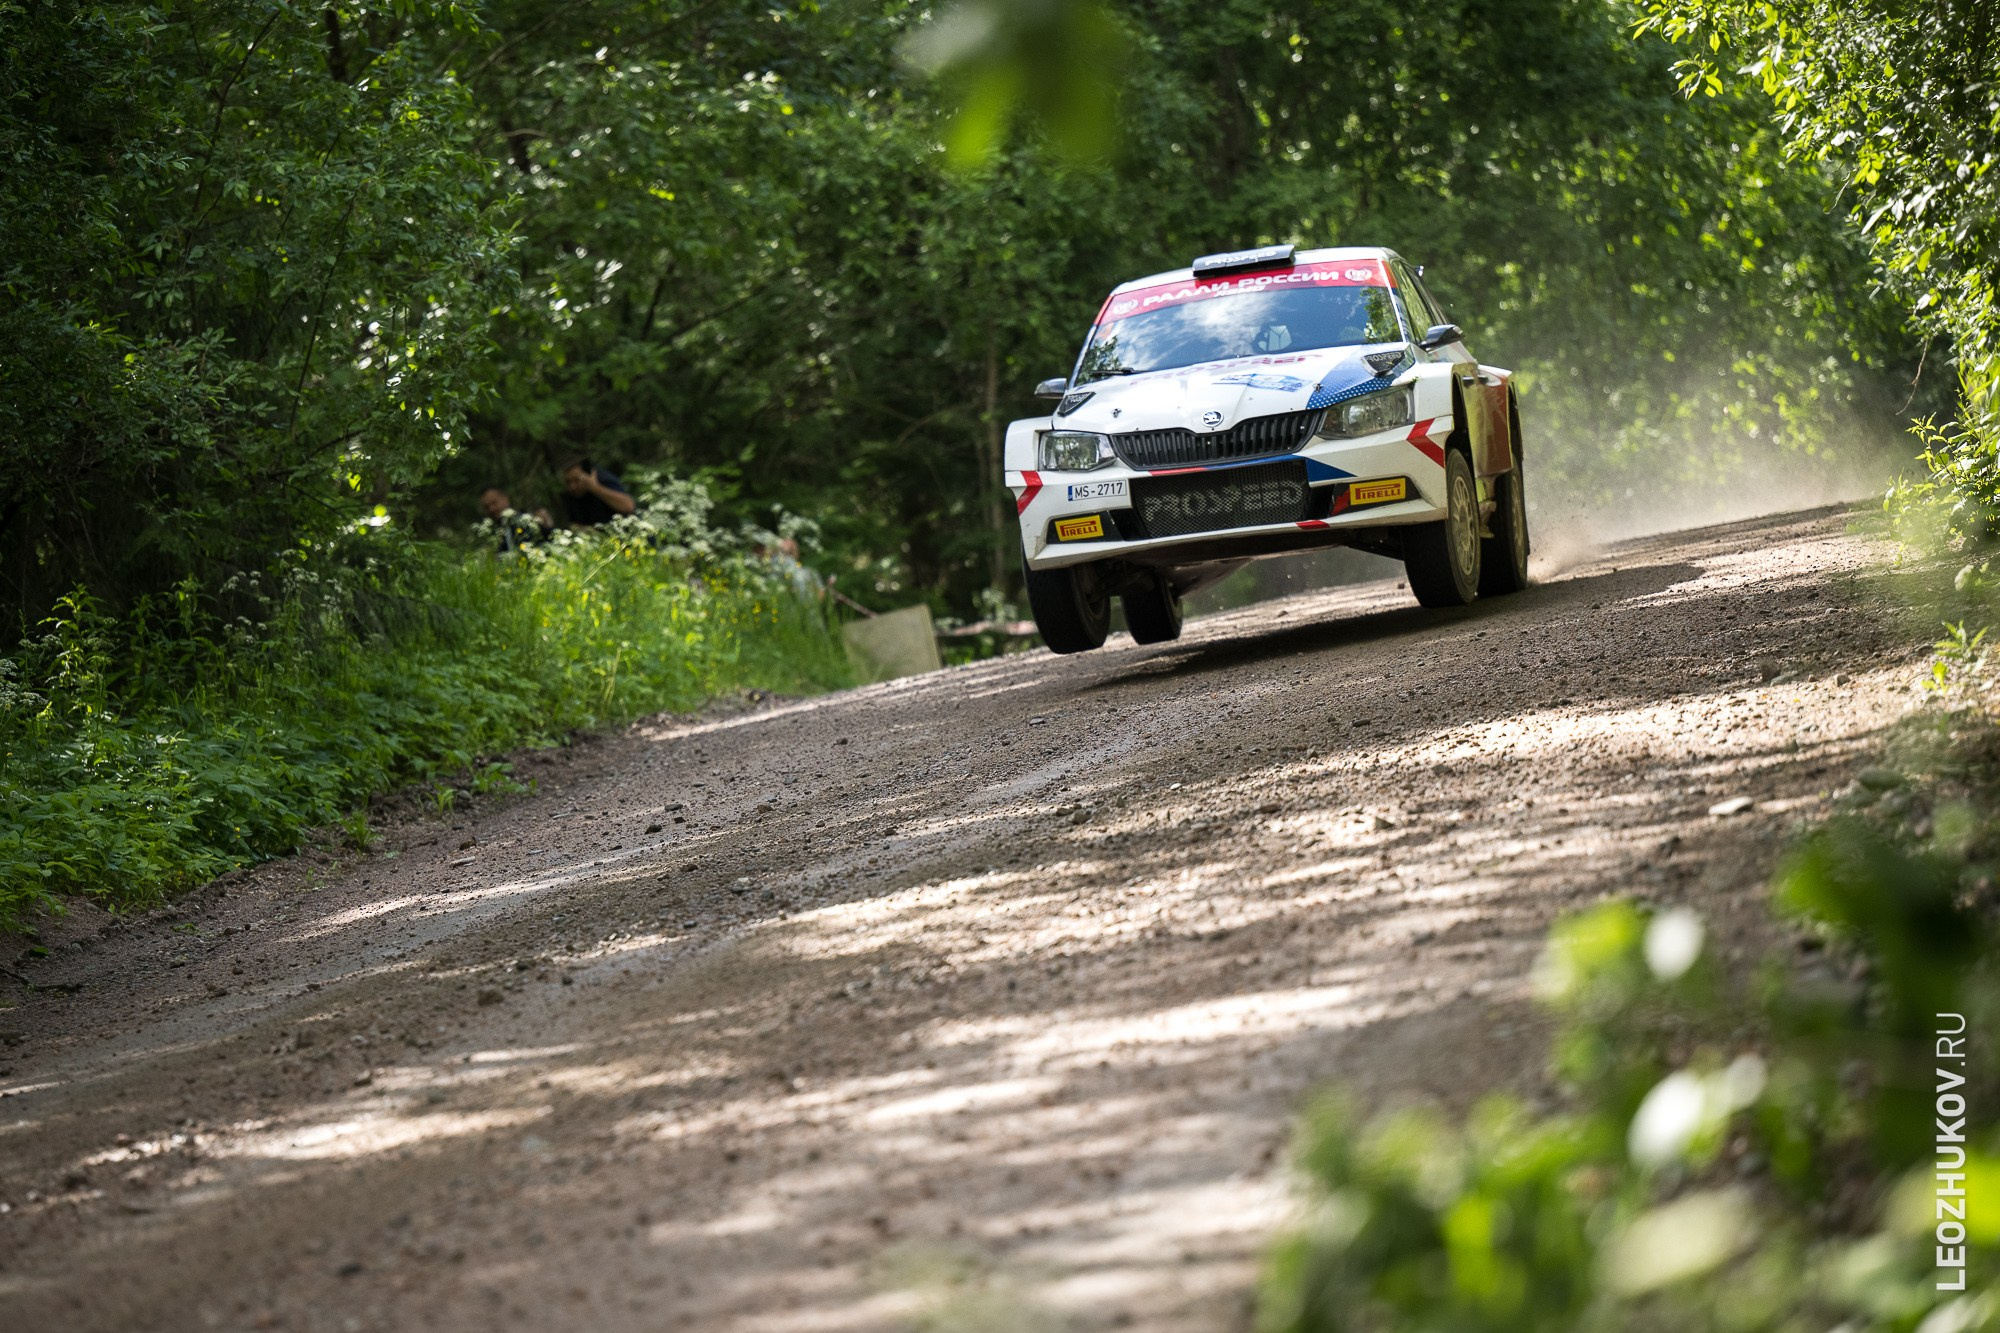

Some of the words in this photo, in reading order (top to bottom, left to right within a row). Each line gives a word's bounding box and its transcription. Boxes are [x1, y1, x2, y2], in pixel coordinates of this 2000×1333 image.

[1143, 281, 1230, 307] РАЛЛИ
[1238, 271, 1339, 288] РОССИИ
[1074, 482, 1123, 499] MS-2717
[1354, 483, 1401, 500] PIRELLI
[1060, 520, 1098, 538] PIRELLI
